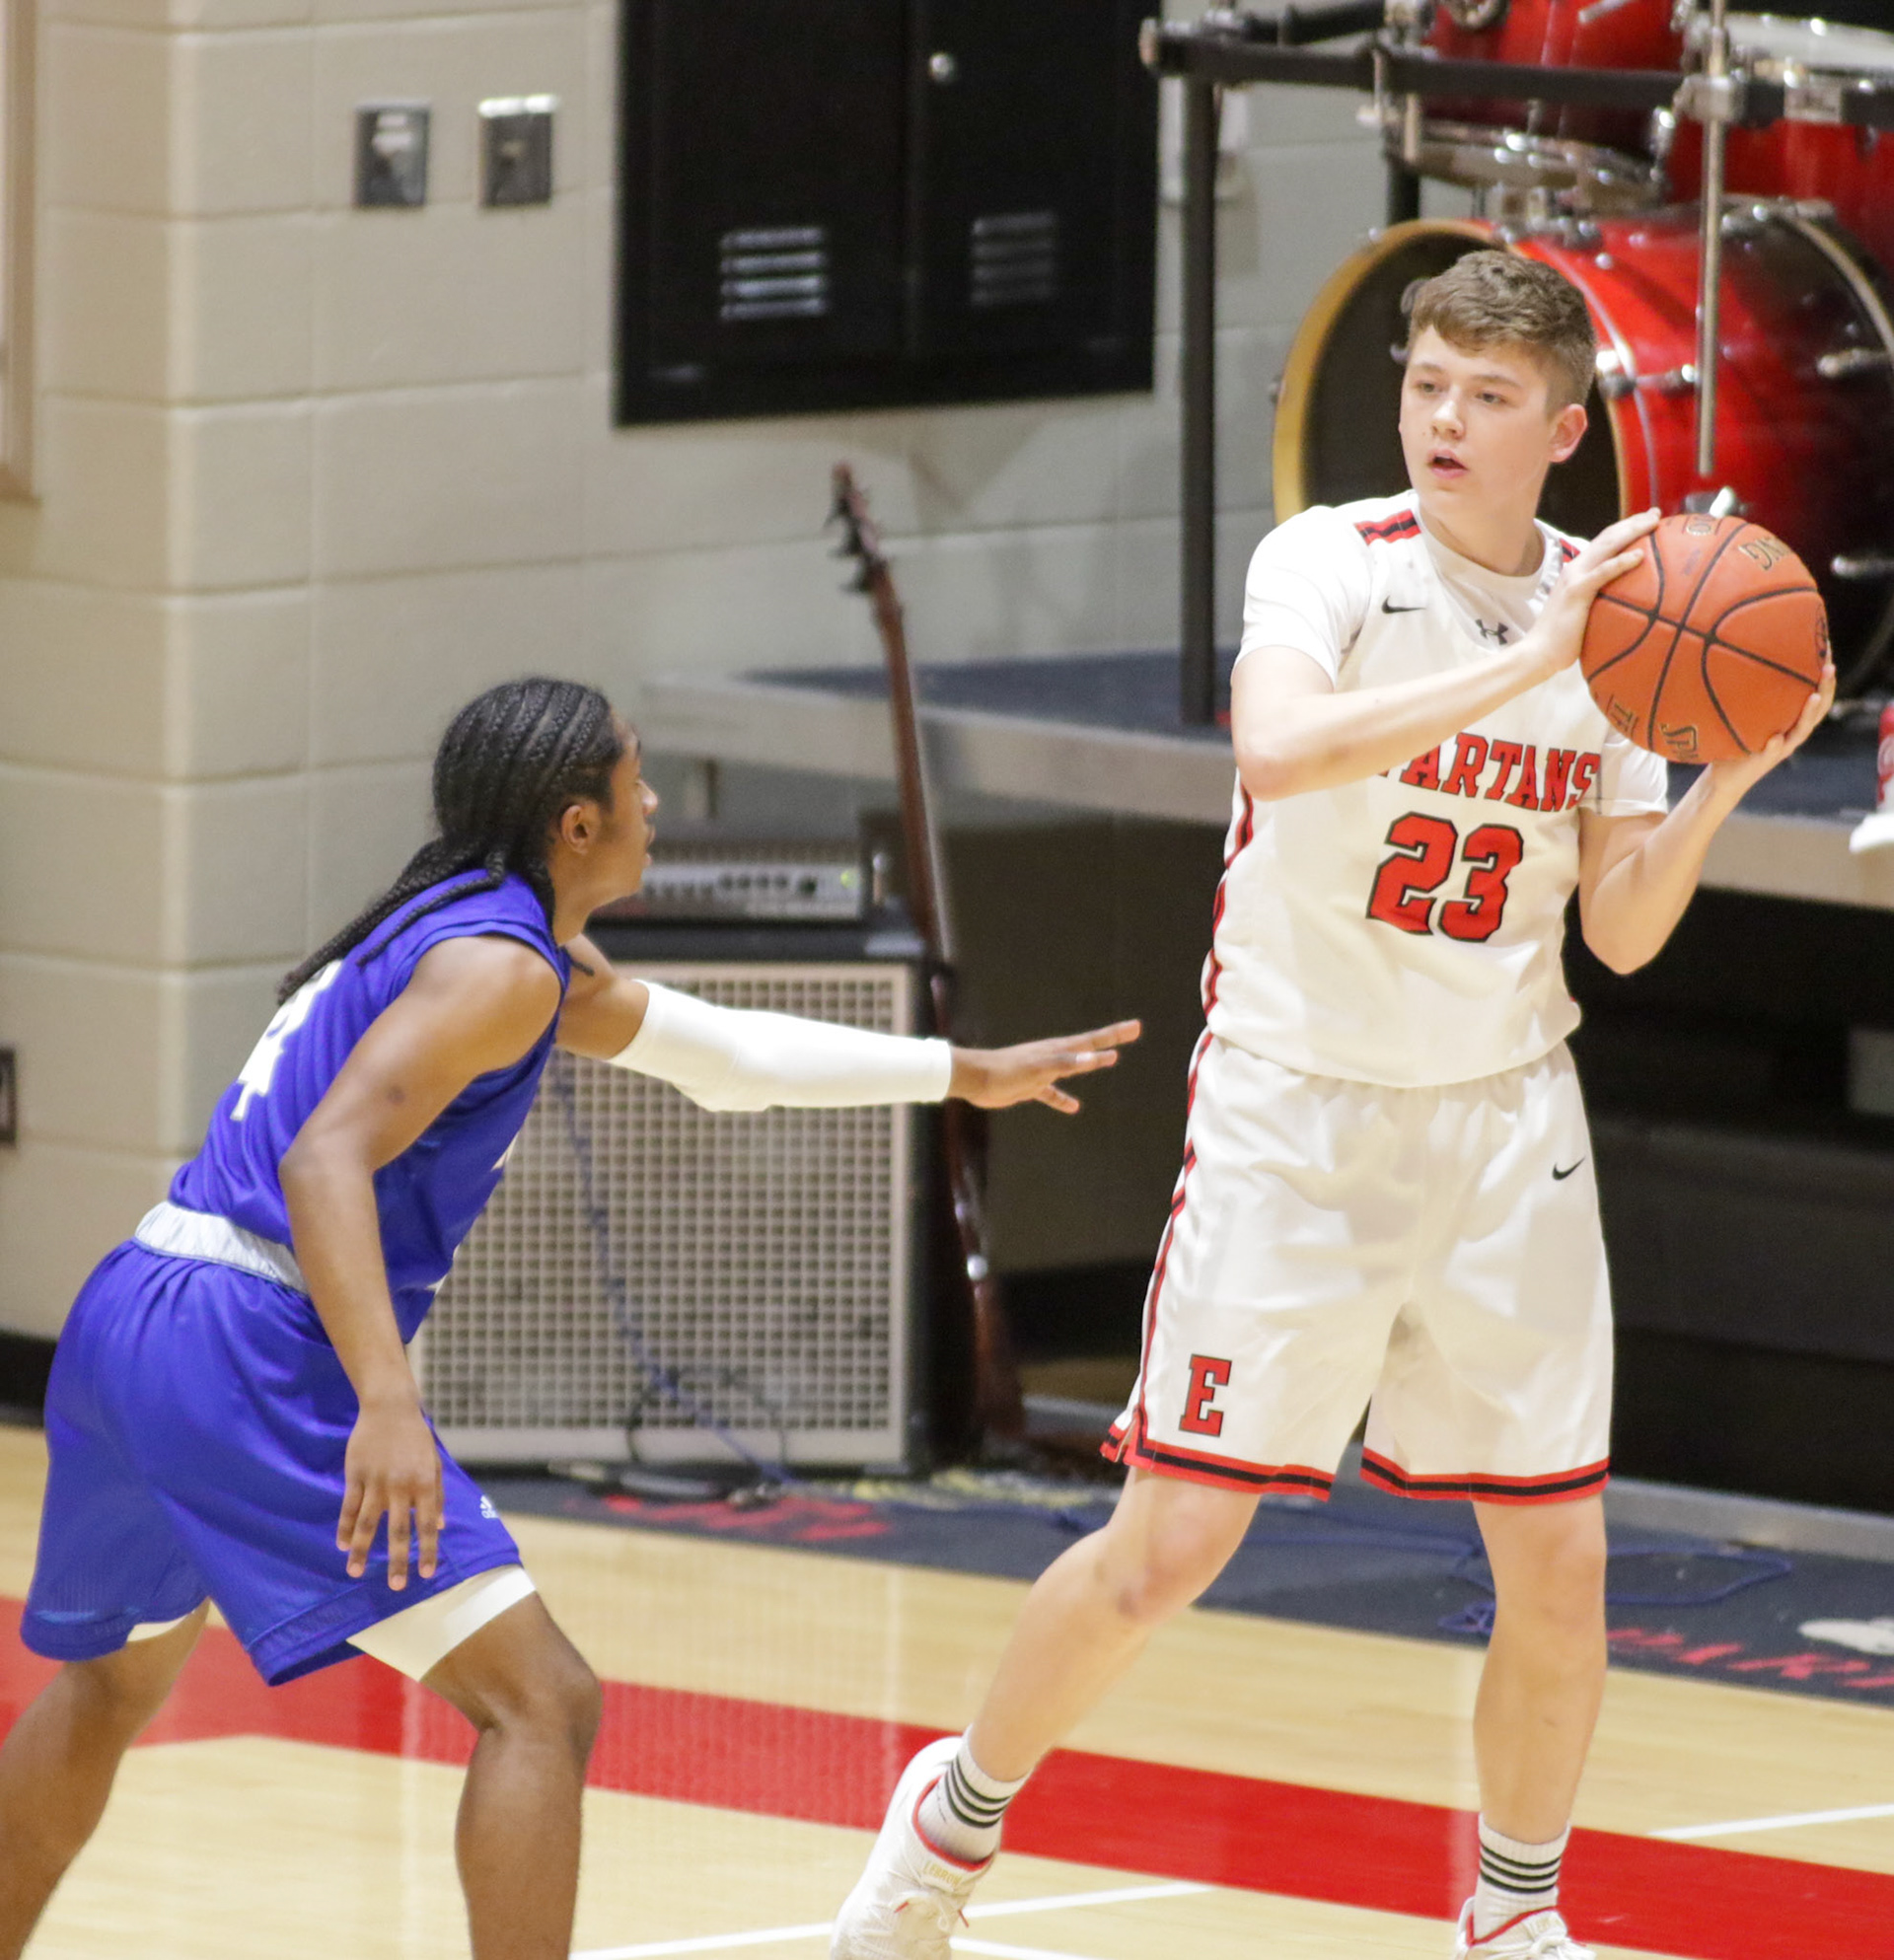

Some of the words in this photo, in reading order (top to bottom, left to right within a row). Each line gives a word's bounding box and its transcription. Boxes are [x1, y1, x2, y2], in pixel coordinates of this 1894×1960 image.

[1376, 732, 1601, 812] ARTANS
[1365, 810, 1524, 943] 23
[1178, 1352, 1232, 1437] E
